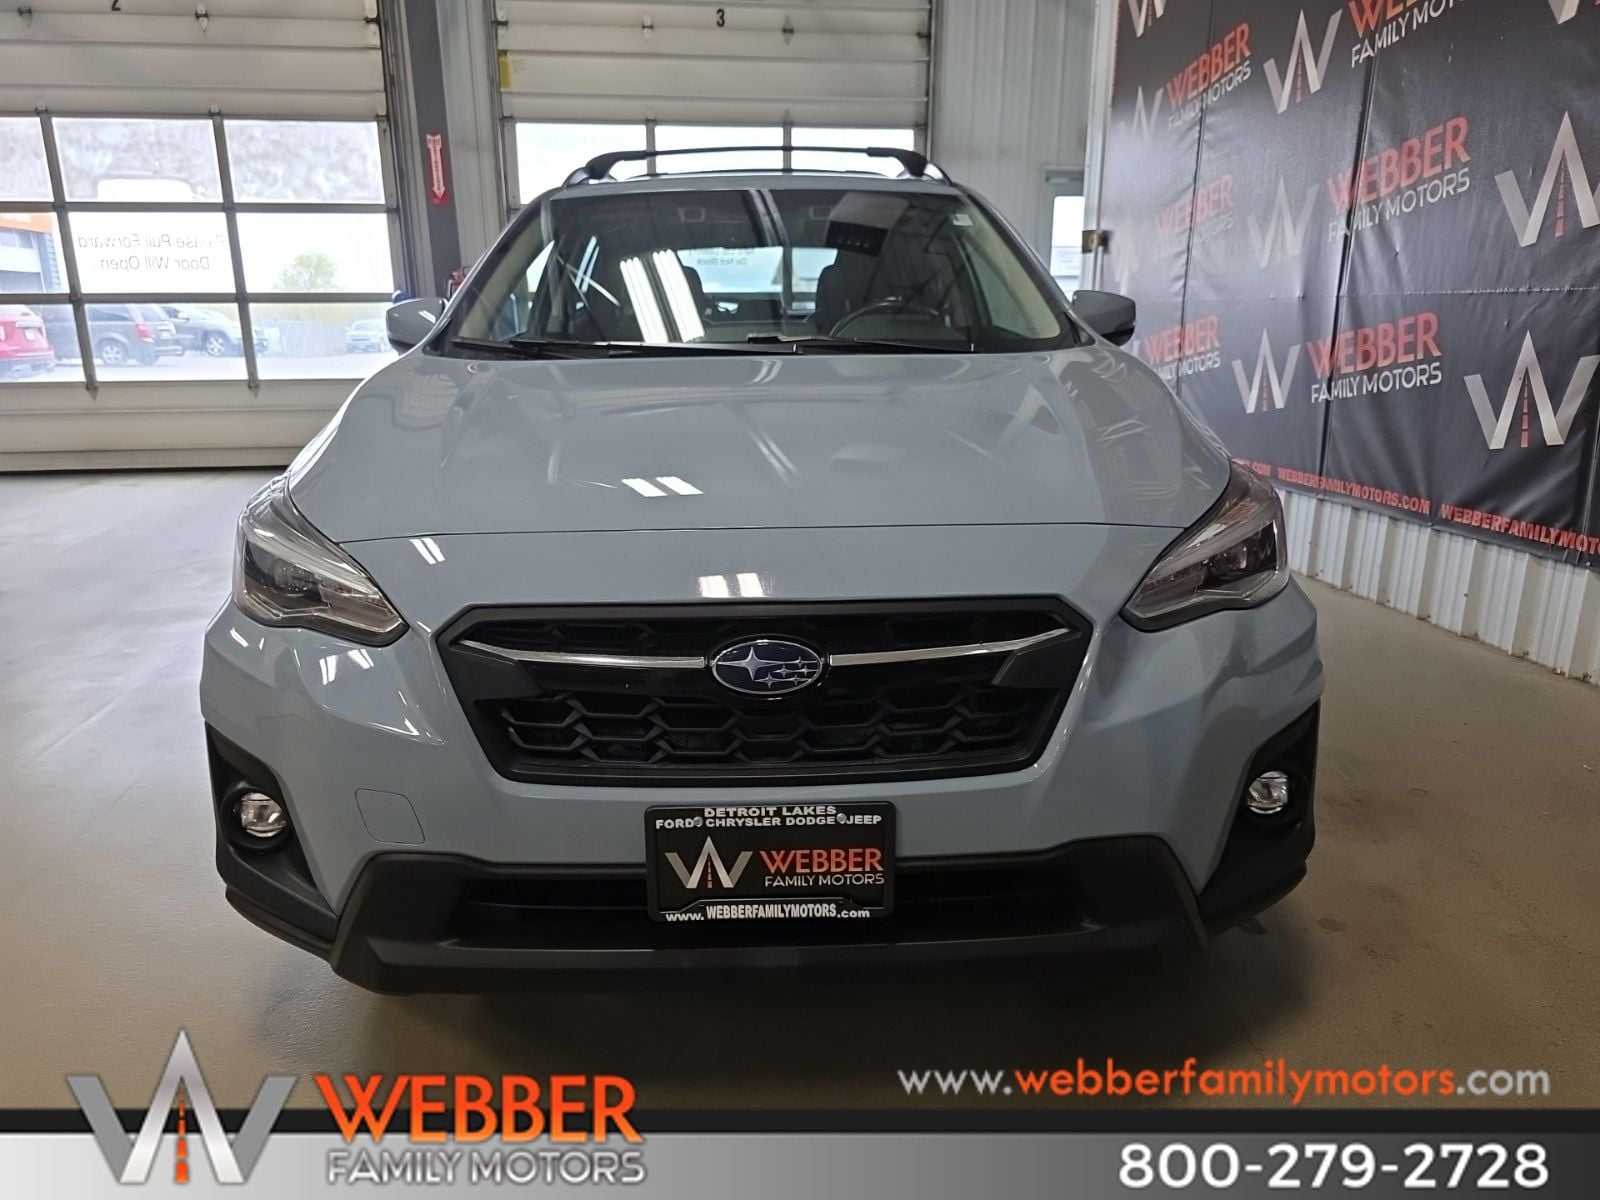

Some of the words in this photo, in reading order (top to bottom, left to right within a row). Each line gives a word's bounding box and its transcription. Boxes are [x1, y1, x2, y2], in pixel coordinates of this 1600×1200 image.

[716, 8, 726, 28] 3
[1351, 12, 1409, 68] FAMILY
[1166, 22, 1252, 110] WEBBER
[1203, 60, 1252, 106] MOTORS
[1326, 116, 1471, 216] WEBBER
[1386, 167, 1471, 221] MOTORS
[1306, 312, 1443, 380] WEBBER
[1311, 375, 1361, 404] FAMILY
[1362, 361, 1443, 395] MOTORS
[1277, 467, 1431, 515] WEBBERFAMILYMOTORS.COM
[655, 819, 695, 830] FORD
[705, 817, 782, 828] CHRYSLER
[785, 815, 836, 826] DODGE
[845, 814, 882, 825] JEEP
[704, 807, 777, 818] DETROIT
[782, 805, 837, 816] LAKES
[759, 847, 885, 875] WEBBER
[764, 875, 816, 888] FAMILY
[818, 873, 885, 886] MOTORS
